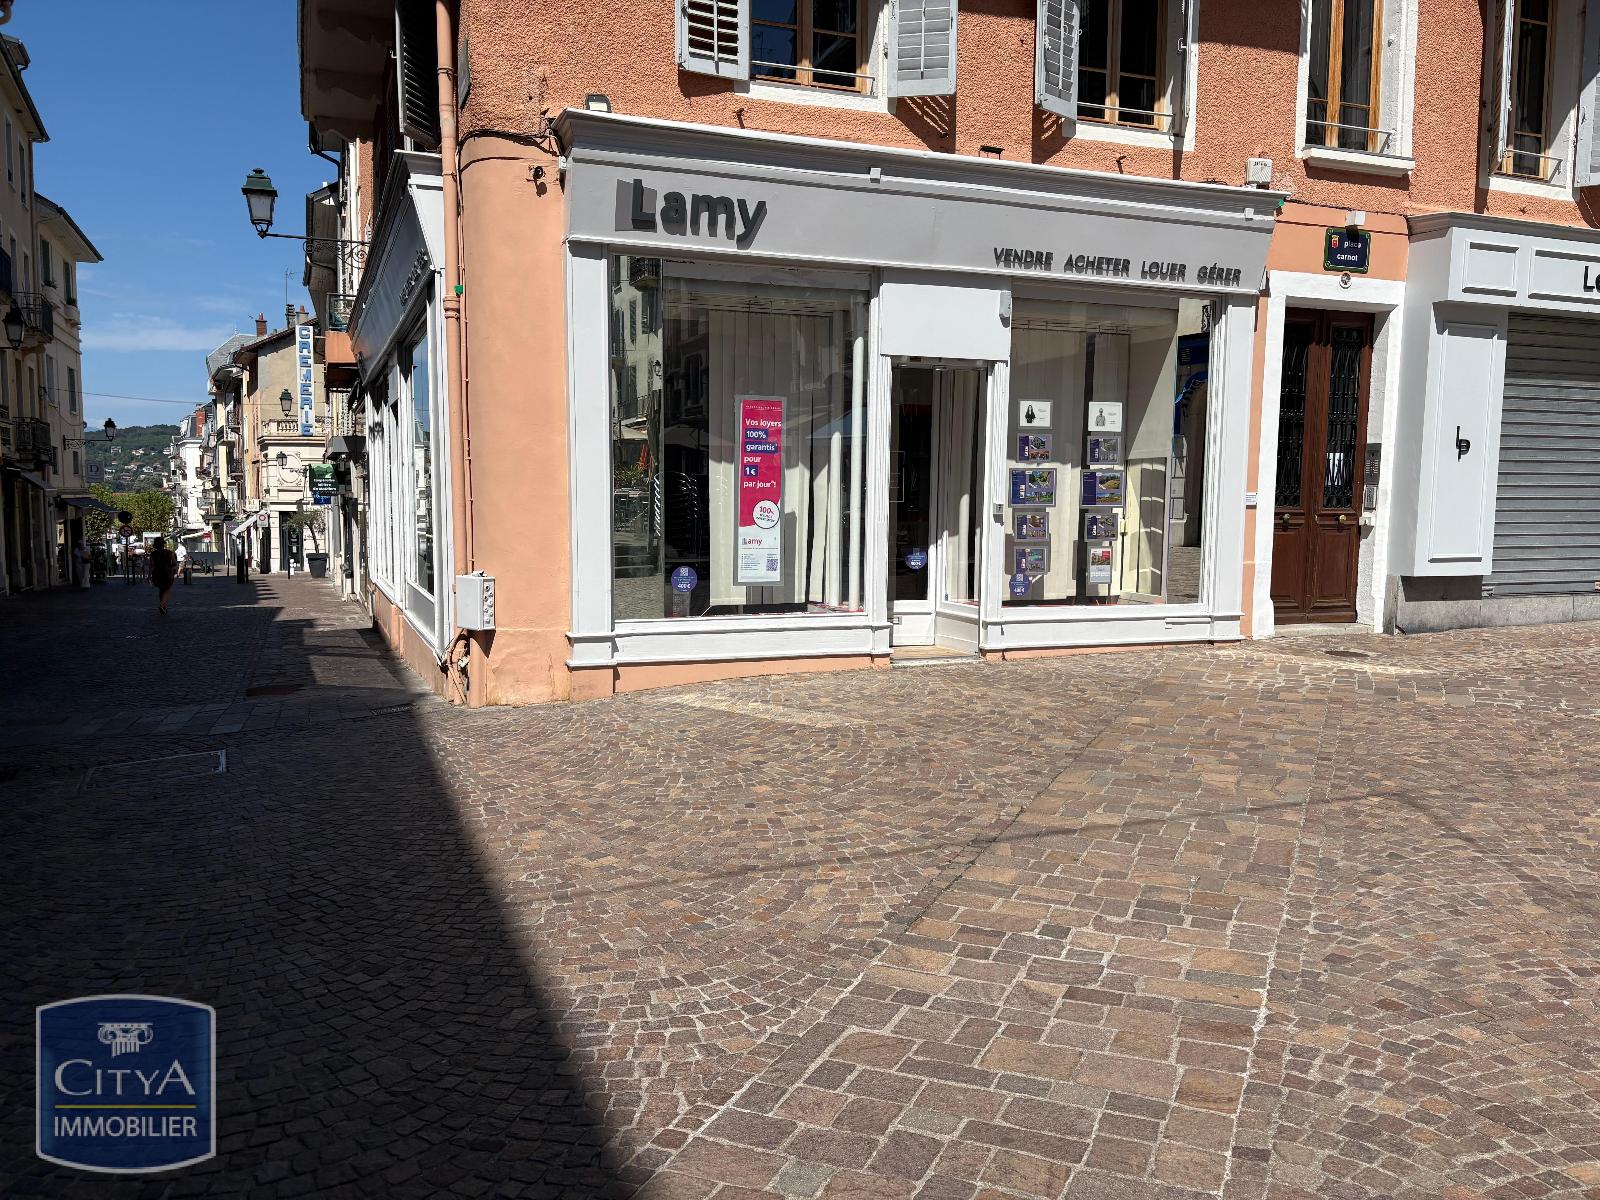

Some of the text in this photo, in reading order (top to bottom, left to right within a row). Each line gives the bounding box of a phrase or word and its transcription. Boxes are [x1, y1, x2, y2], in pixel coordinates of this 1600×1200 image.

[631, 178, 767, 250] Lamy
[1344, 240, 1362, 249] place
[1336, 253, 1359, 262] carnot
[994, 248, 1241, 284] VENDRE ACHETER LOUER GÉRER
[745, 418, 782, 429] Vos loyers
[746, 430, 767, 439] 100%
[744, 456, 761, 464] pour
[90, 464, 99, 473] D
[743, 481, 756, 489] par
[743, 537, 763, 546] Lamy
